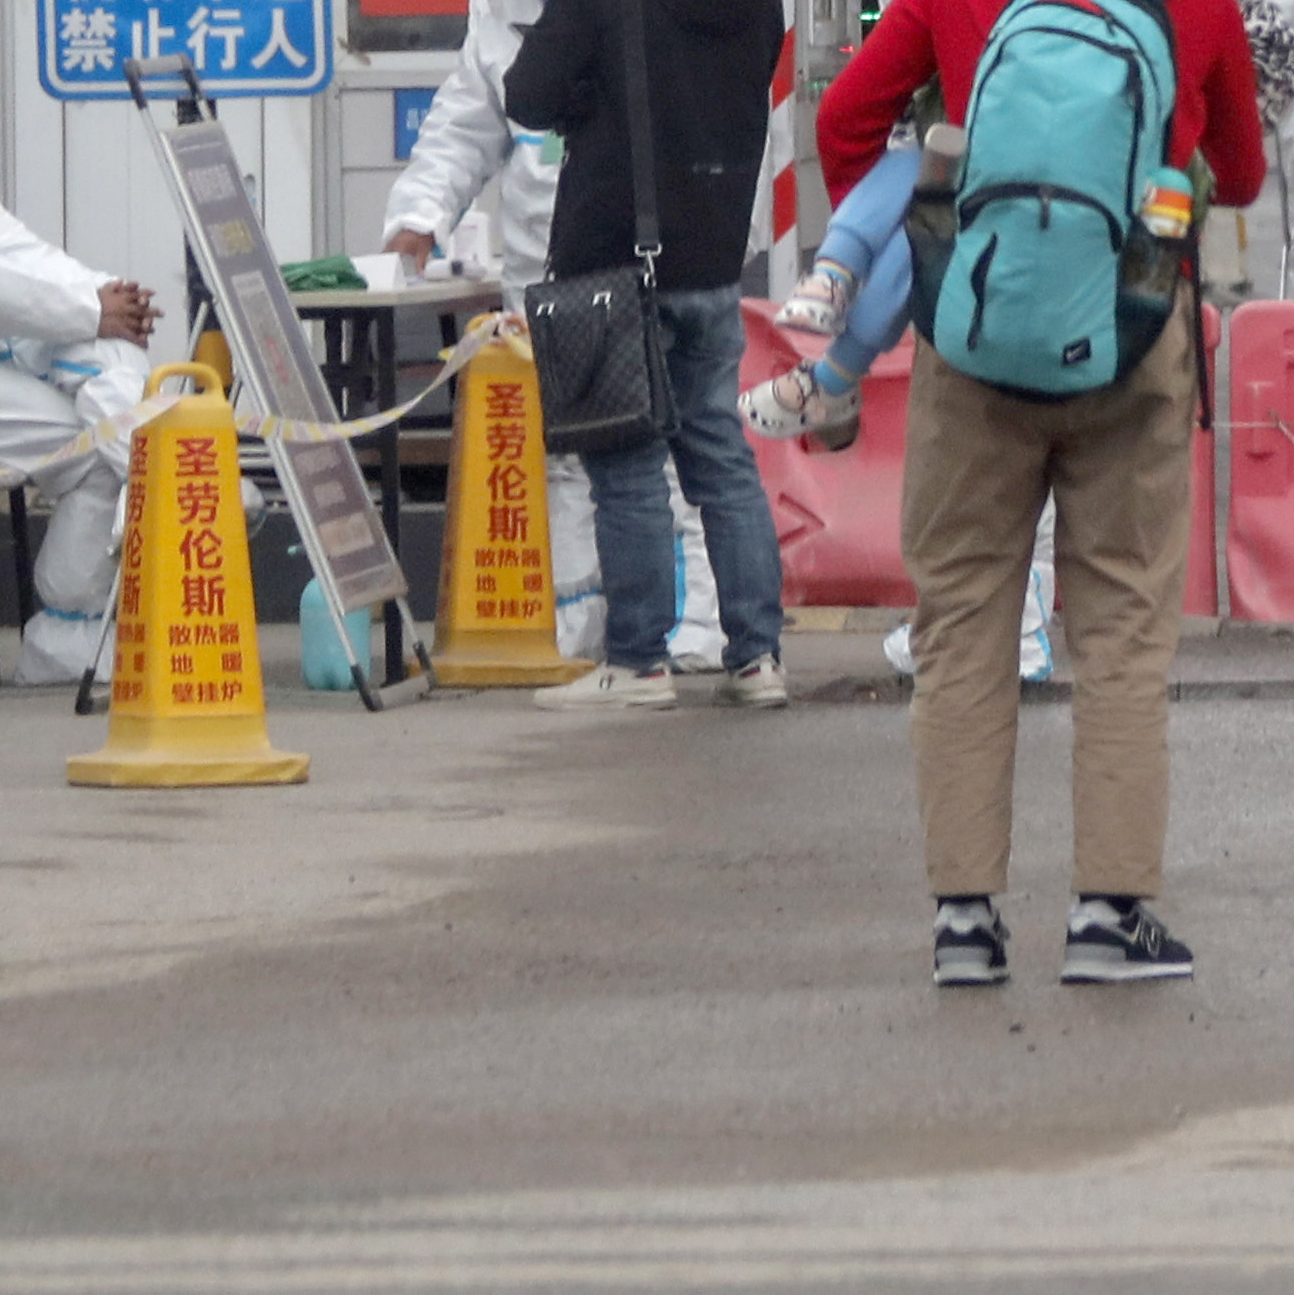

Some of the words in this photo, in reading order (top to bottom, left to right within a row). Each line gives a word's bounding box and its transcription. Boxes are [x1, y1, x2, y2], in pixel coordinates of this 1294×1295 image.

[60, 7, 308, 72] 禁止行人
[122, 436, 148, 616] 圣劳伦斯
[175, 437, 226, 617] 圣劳伦斯
[485, 383, 530, 542] 圣劳伦斯
[168, 623, 241, 647] 散热器
